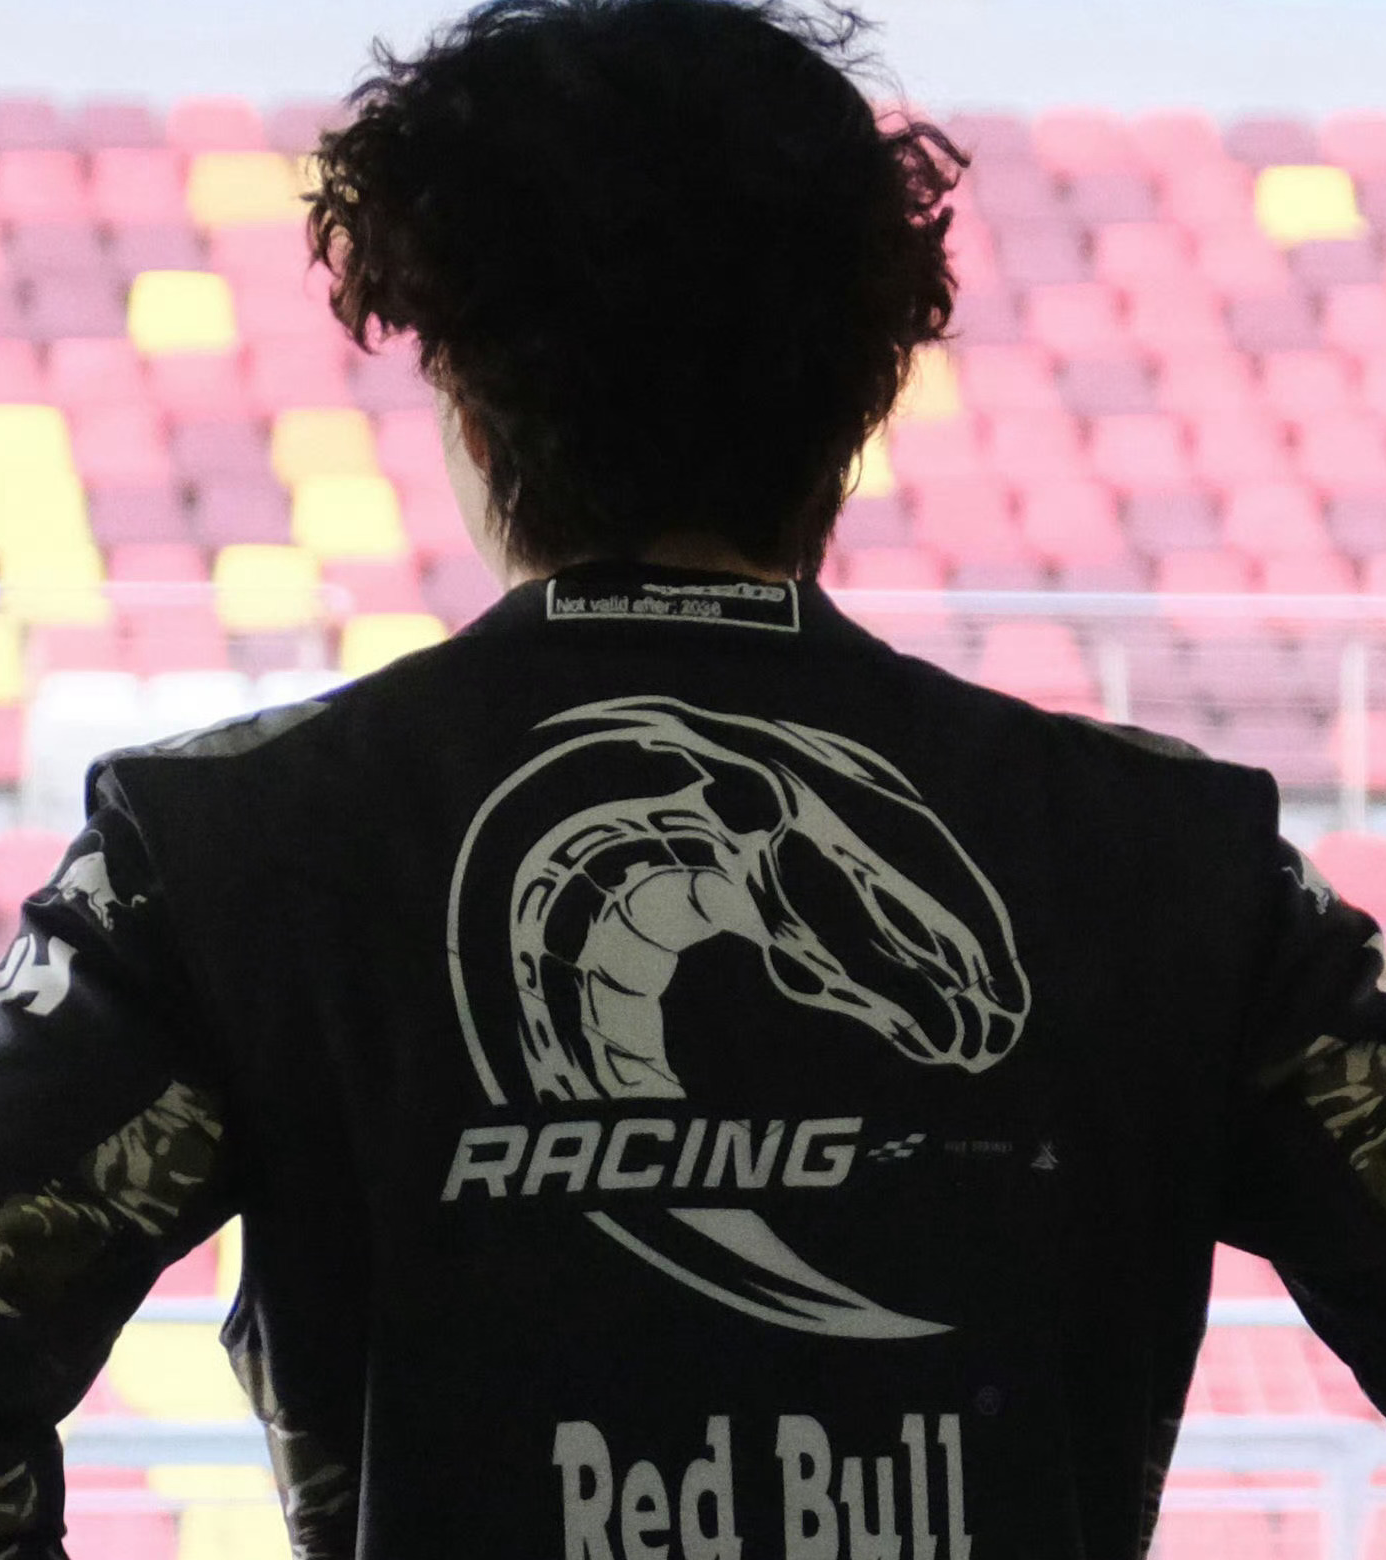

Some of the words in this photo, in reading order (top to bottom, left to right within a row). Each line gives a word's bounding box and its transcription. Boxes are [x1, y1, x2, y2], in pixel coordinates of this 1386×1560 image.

[555, 597, 585, 613] Not
[590, 595, 629, 613] valid
[440, 1116, 864, 1202] RACING
